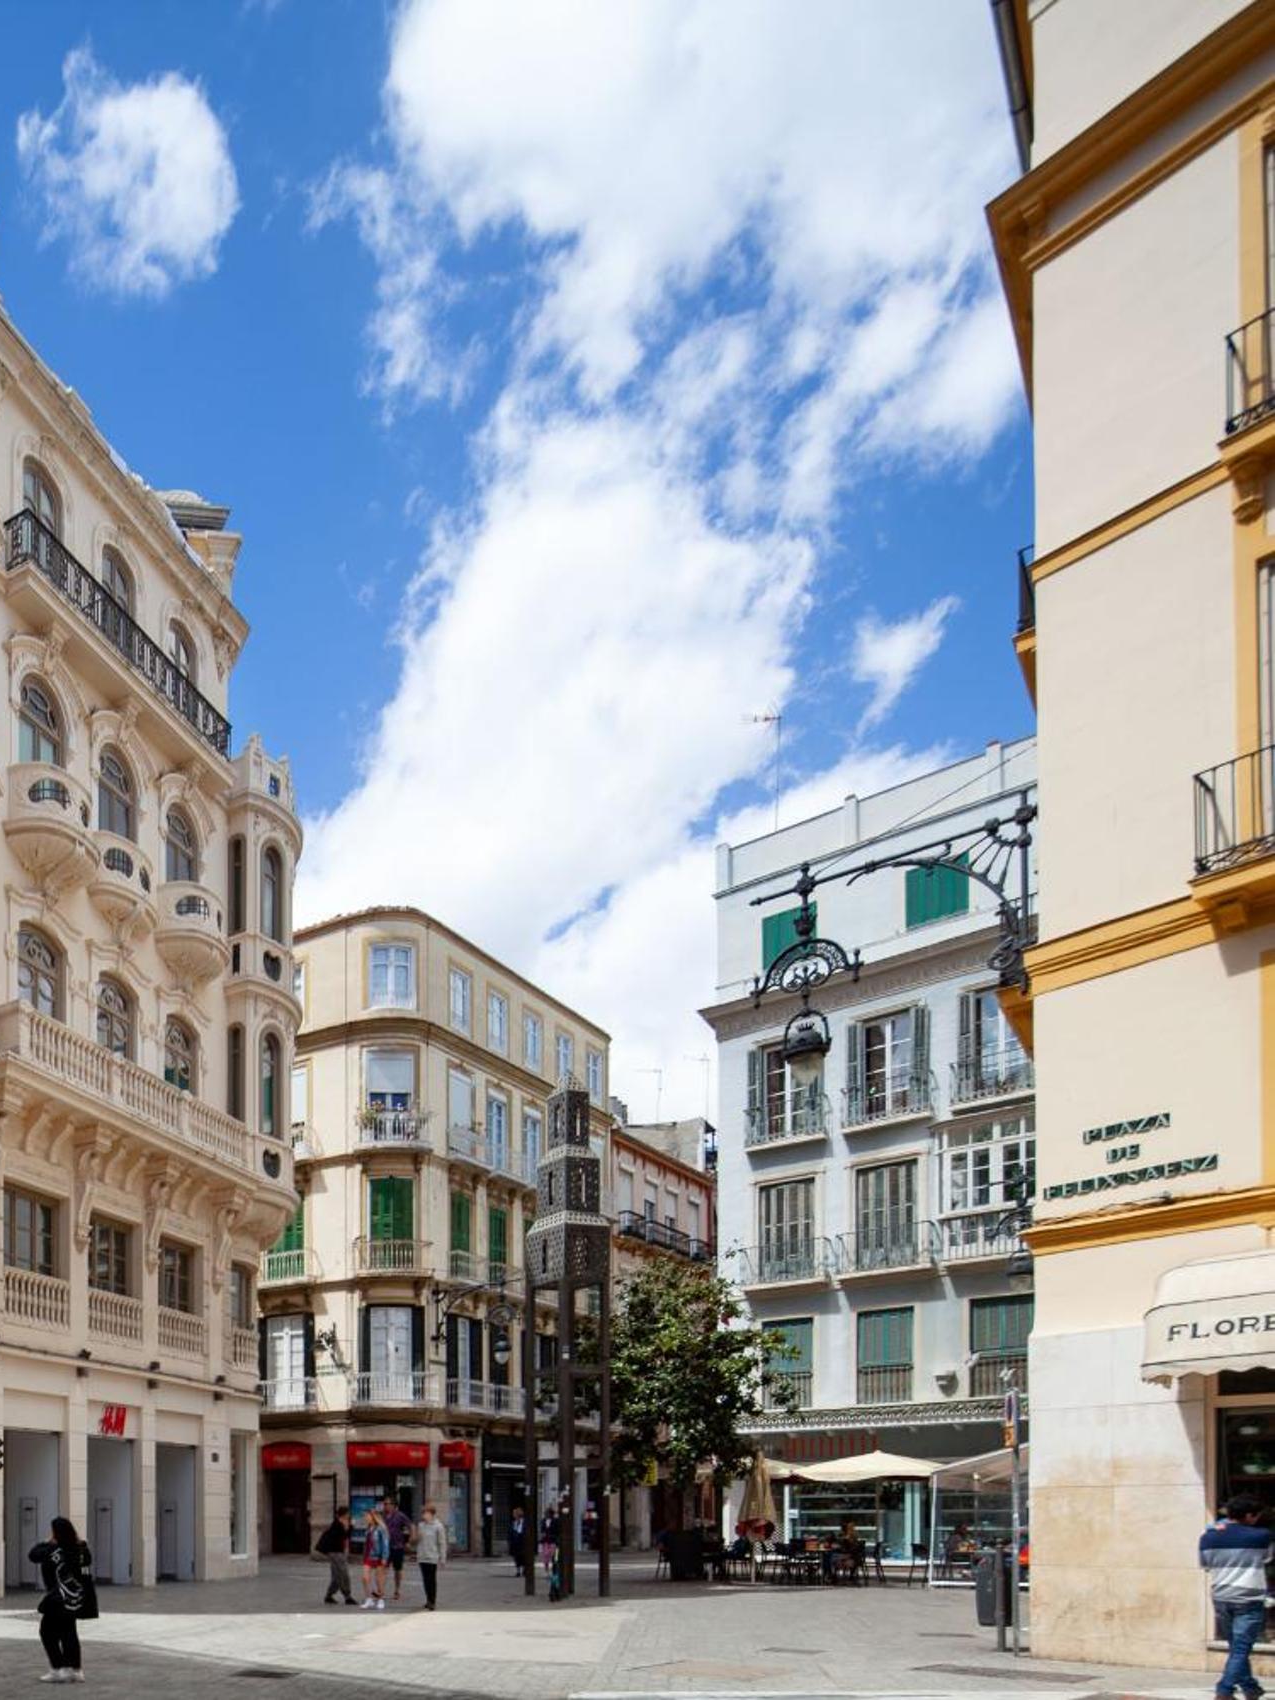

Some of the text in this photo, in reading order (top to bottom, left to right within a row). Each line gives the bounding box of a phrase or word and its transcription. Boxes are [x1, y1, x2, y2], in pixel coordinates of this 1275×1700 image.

[1083, 1113, 1170, 1144] PLAZA
[1107, 1144, 1140, 1164] DE
[1167, 1313, 1275, 1342] FLORE
